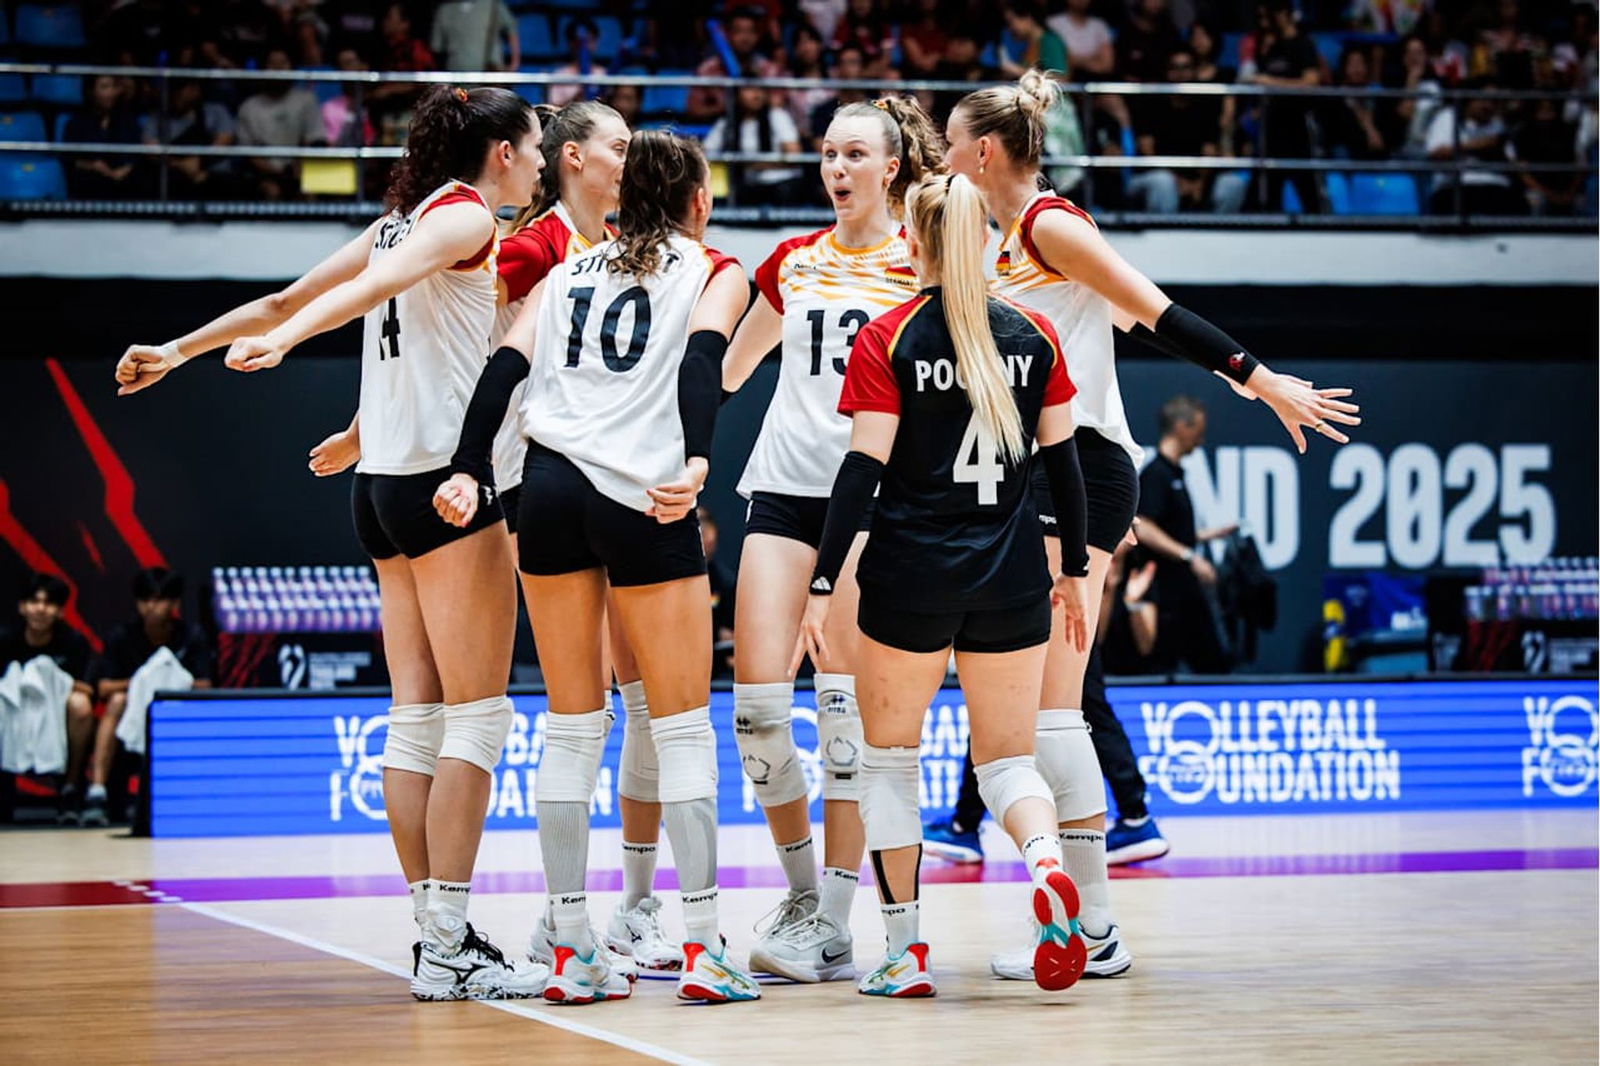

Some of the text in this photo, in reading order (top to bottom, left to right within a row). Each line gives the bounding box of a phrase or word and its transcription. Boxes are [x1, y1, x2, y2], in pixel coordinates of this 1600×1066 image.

[567, 285, 652, 373] 10
[807, 308, 871, 376] 13
[953, 404, 1004, 505] 4
[1329, 442, 1556, 569] 2025
[1140, 698, 1387, 756] VOLLEYBALL
[1137, 749, 1401, 805] FOUNDATION
